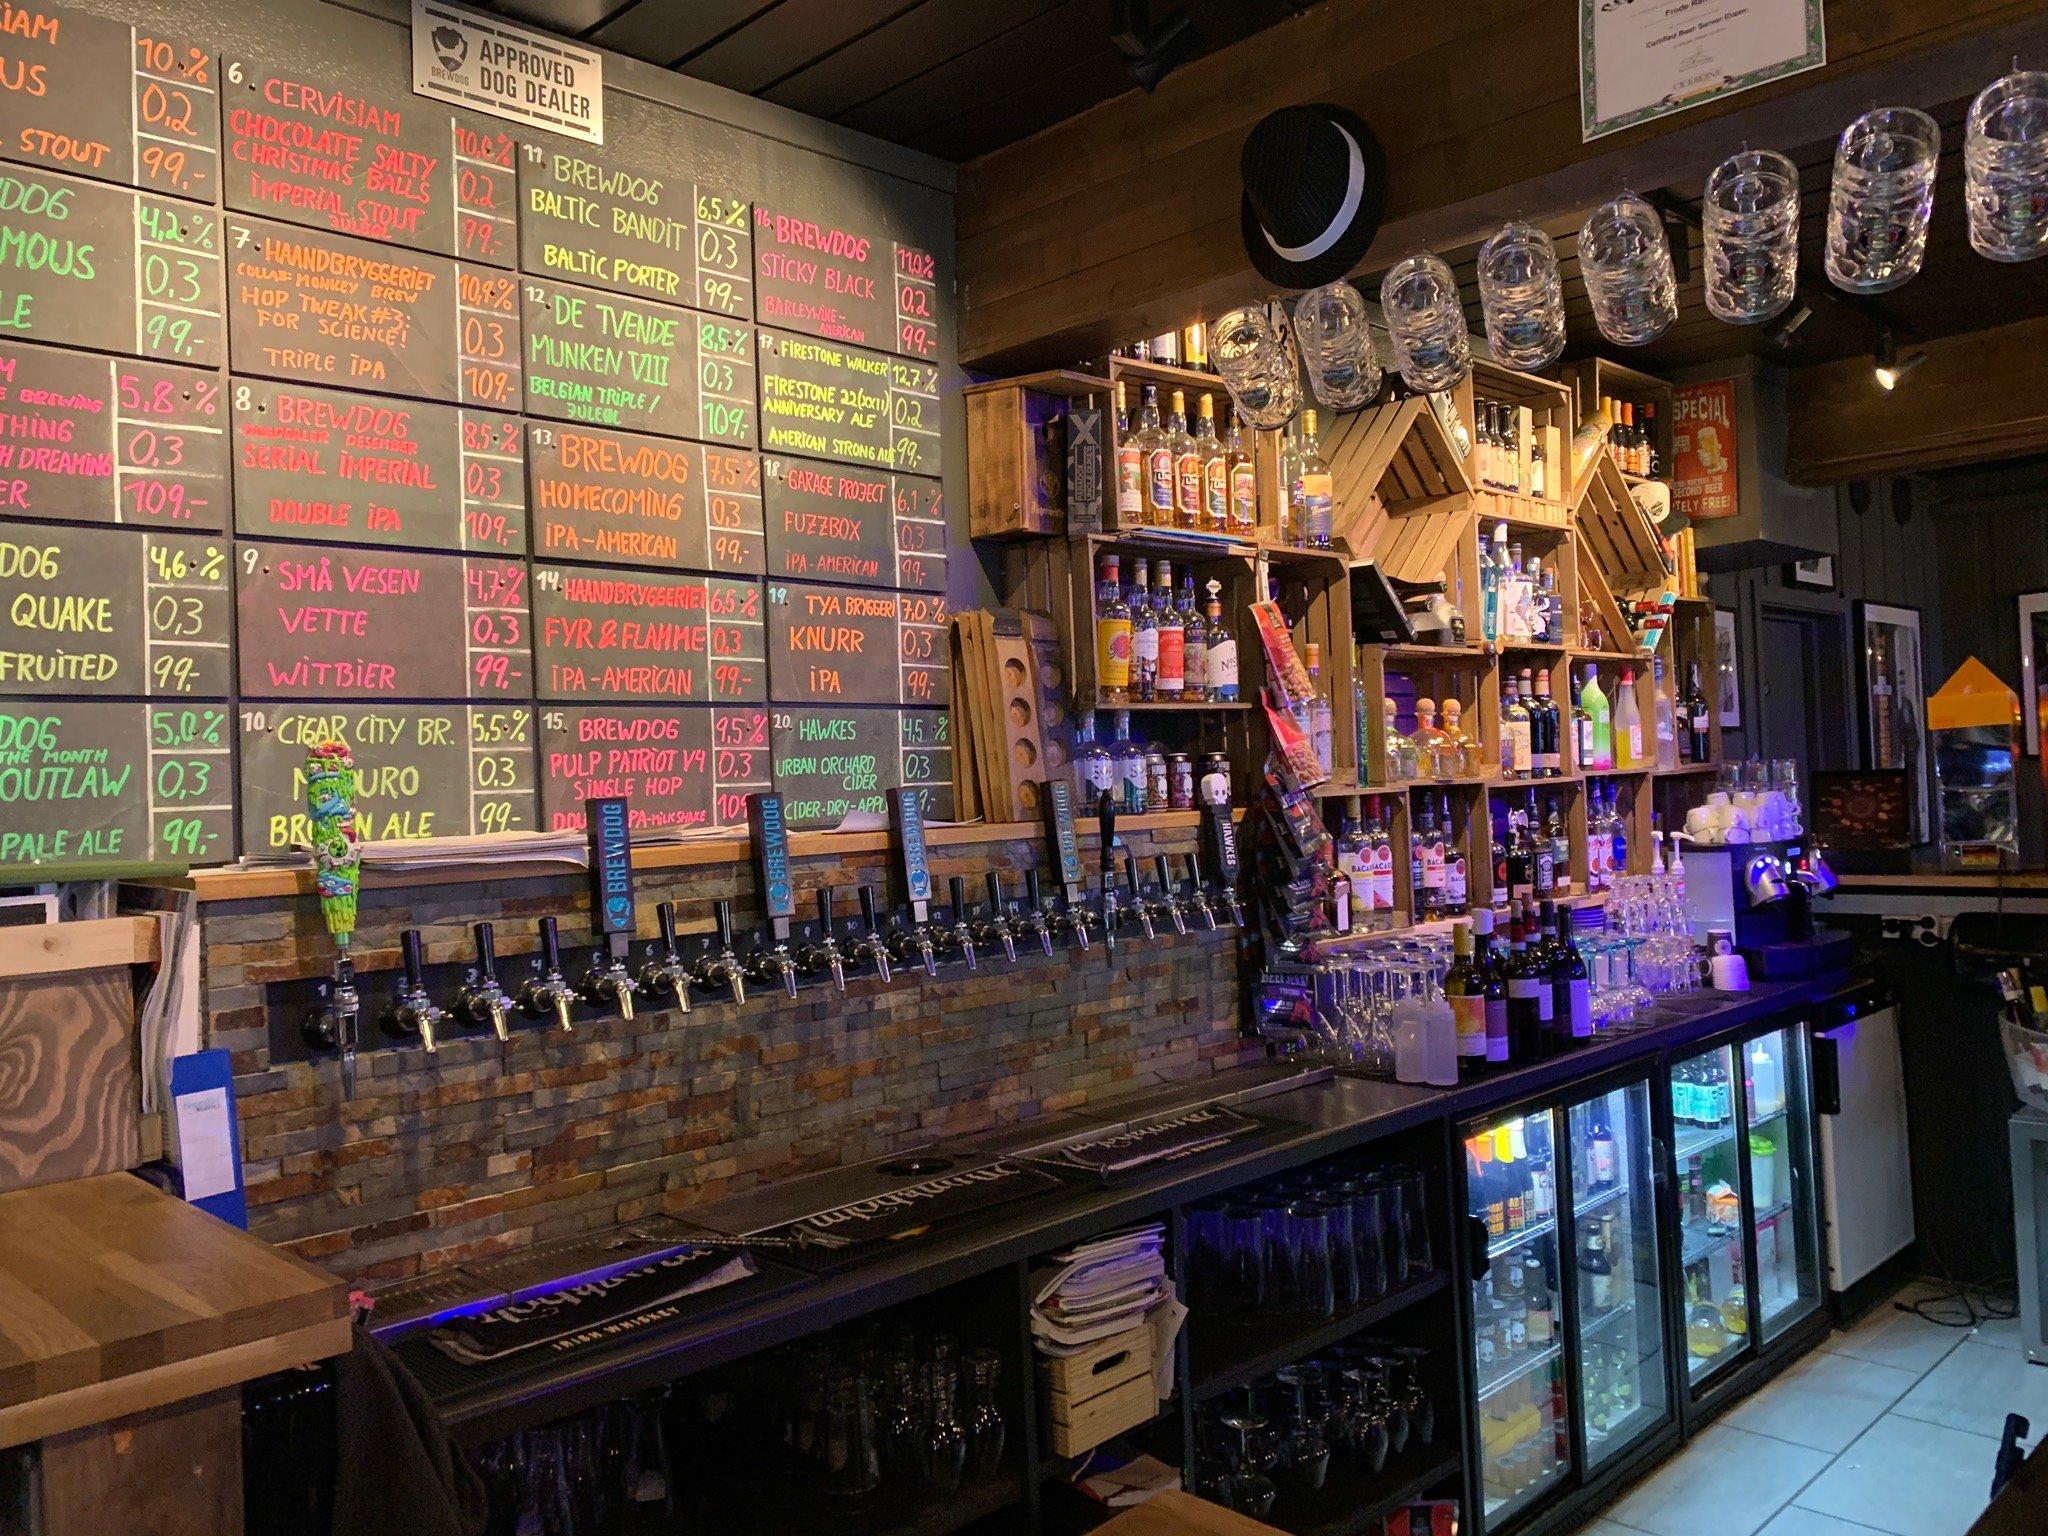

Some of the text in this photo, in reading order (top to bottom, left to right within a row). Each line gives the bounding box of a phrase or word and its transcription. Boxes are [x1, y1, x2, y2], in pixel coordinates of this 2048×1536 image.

[431, 67, 469, 86] BREWDOG
[480, 39, 575, 88] APPROVED
[480, 66, 590, 119] DOG DEALER
[21, 128, 110, 168] STOUT
[229, 108, 437, 178] CHOCOLATE SALTY
[367, 168, 430, 203] BALLS
[553, 155, 663, 205] BREWDOG
[357, 200, 425, 233] STOUT
[776, 215, 871, 262] BREWDOG
[613, 258, 680, 295] PORTER
[824, 268, 875, 300] BLACK
[241, 285, 367, 323] HOP TWEAK
[257, 310, 299, 330] FOR
[554, 295, 679, 347] DE TVENDE
[531, 333, 669, 387] MUNKEN VIII
[846, 354, 888, 378] WALKER
[277, 394, 410, 438] BREWDOG
[850, 413, 877, 429] ALE
[1673, 394, 1730, 429] SPECIAL
[560, 433, 689, 484] BREWDOG
[832, 438, 876, 460] STRONG
[788, 469, 834, 497] GARAGE
[838, 478, 886, 504] PROJECT
[269, 499, 352, 527] DOUBLE
[784, 511, 862, 541] FUZZBOX
[278, 556, 333, 593] SMÅ
[342, 566, 420, 594] VESEN
[11, 593, 113, 633] QUAKE
[279, 607, 368, 636] VETTE
[805, 595, 841, 616] TYA
[544, 617, 707, 652] FYR & FLAMME
[790, 626, 865, 653] KNURR
[579, 718, 680, 743] BREWDOG
[800, 719, 857, 742] HAWKES
[43, 749, 108, 764] MONTH
[550, 751, 601, 778] PULP
[776, 754, 876, 777] URBAN ORCHARD
[0, 764, 130, 801] OUTLAW
[645, 776, 684, 796] HOP
[381, 811, 435, 840] ALE
[902, 791, 924, 867] BREWDOG
[1054, 784, 1078, 851] BREWDOG
[0, 829, 124, 861] PALE ALE
[602, 803, 628, 893] BREWDOG
[762, 799, 787, 880] BREWDOG
[1222, 822, 1236, 866] HAWKES
[553, 1306, 681, 1351] IRISH WHISKEY
